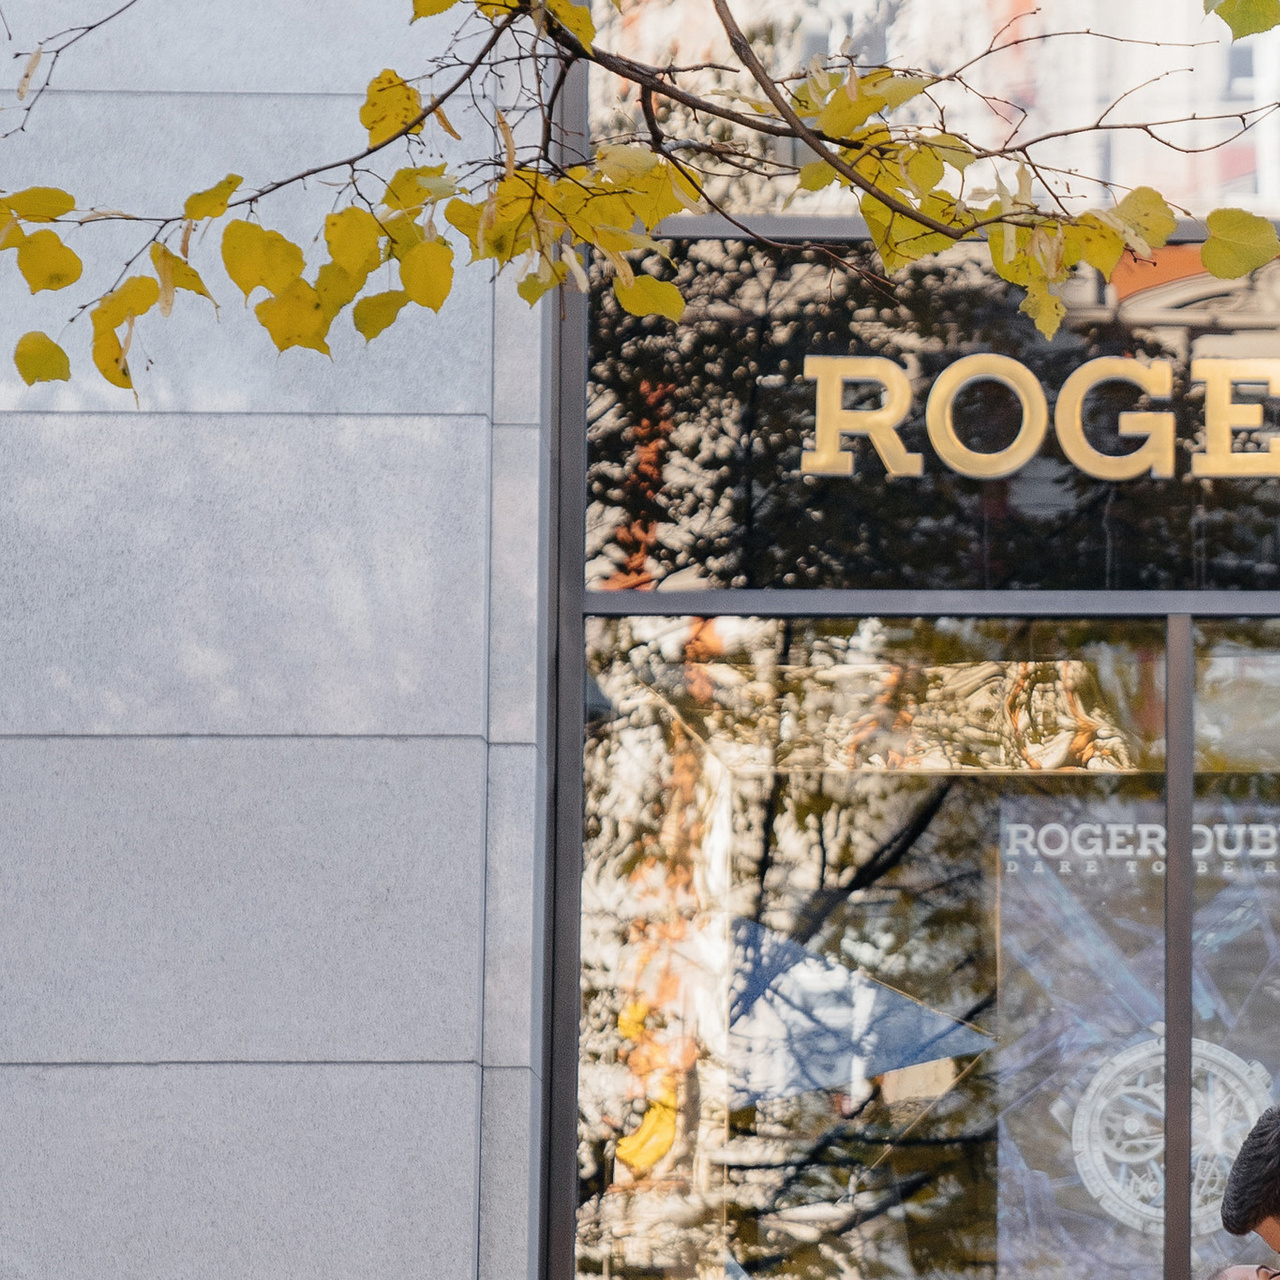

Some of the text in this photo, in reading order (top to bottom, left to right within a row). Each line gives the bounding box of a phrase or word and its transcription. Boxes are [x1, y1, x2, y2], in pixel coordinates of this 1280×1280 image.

[1005, 823, 1166, 857] ROGER
[1005, 860, 1098, 873] DARE
[1126, 860, 1166, 873] TO
[1196, 860, 1235, 873] BE
